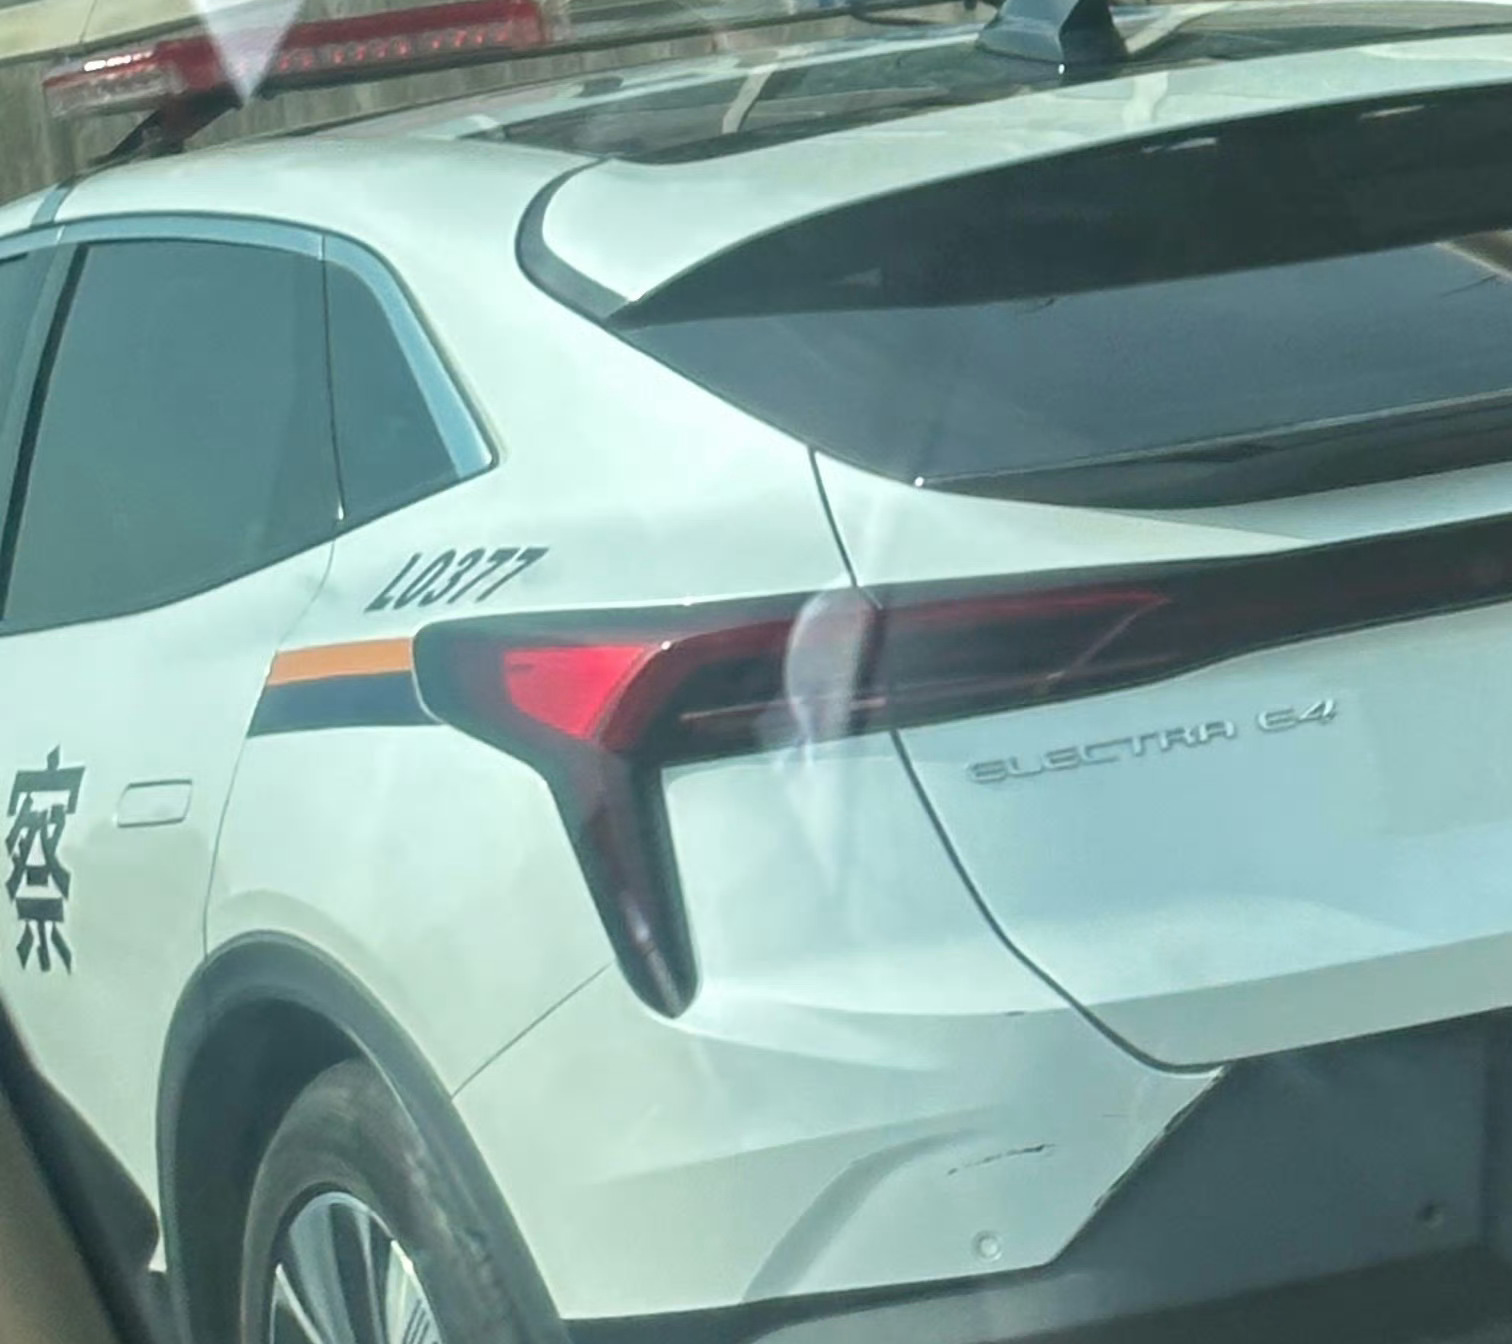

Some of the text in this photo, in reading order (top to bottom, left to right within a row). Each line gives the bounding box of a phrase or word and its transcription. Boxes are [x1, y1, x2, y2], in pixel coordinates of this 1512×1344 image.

[966, 697, 1337, 784] ELECTRA E4
[5, 744, 86, 975] 察
